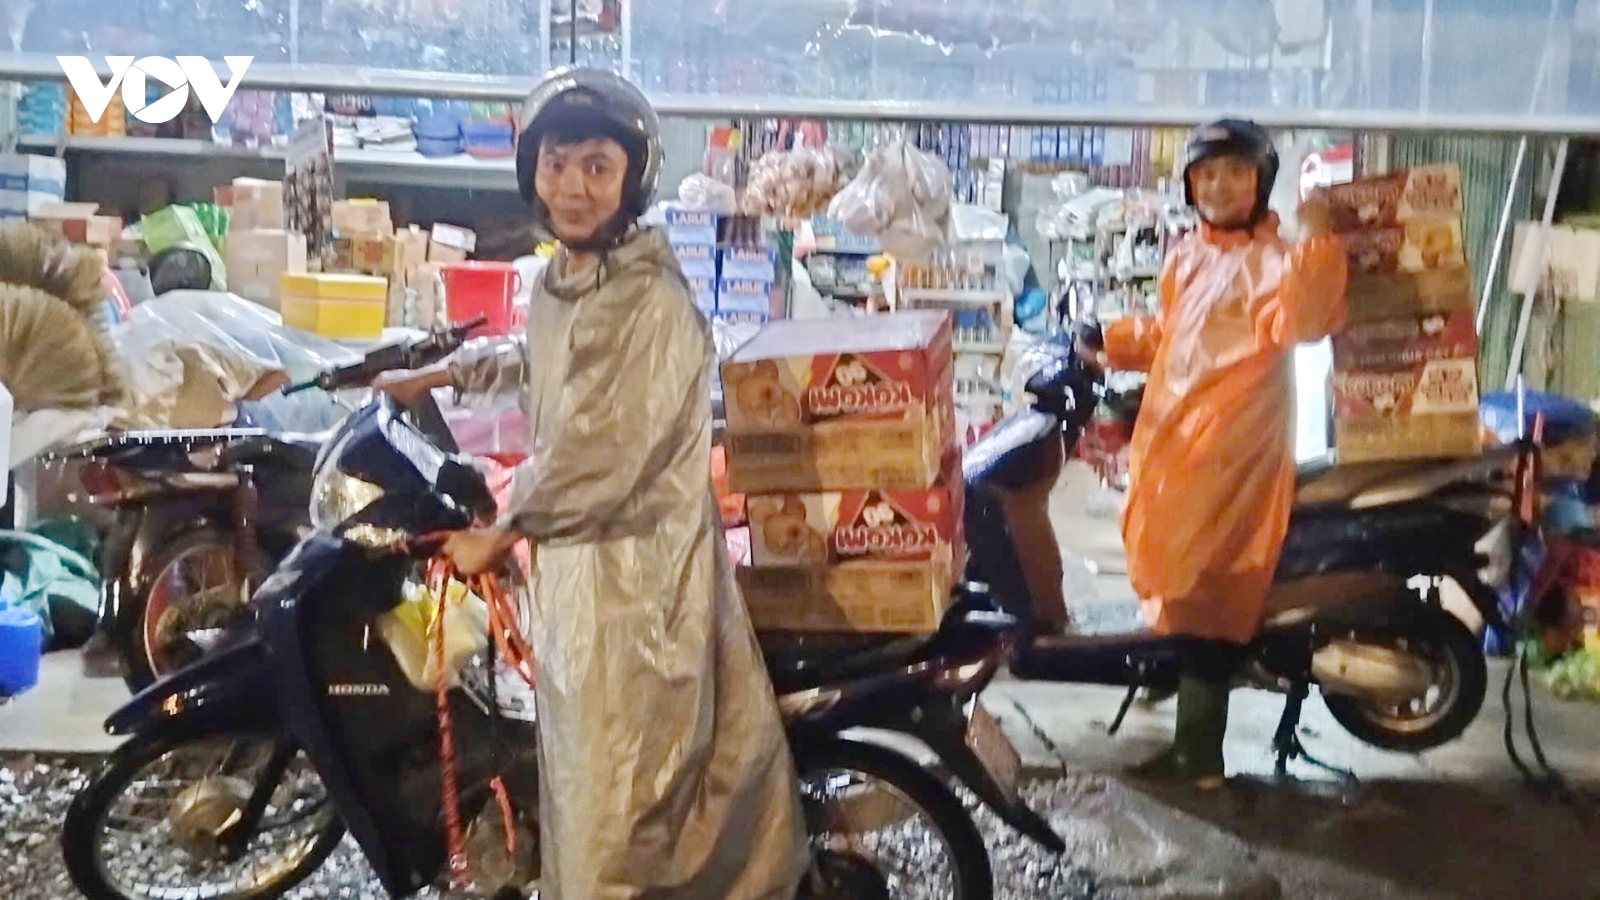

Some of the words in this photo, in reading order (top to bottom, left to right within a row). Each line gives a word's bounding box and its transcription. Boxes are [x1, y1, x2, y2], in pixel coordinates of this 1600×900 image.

[672, 211, 708, 225] LARUE
[809, 381, 911, 412] KOKOMI
[836, 522, 938, 553] KOKOMI
[328, 683, 390, 696] HONDA
